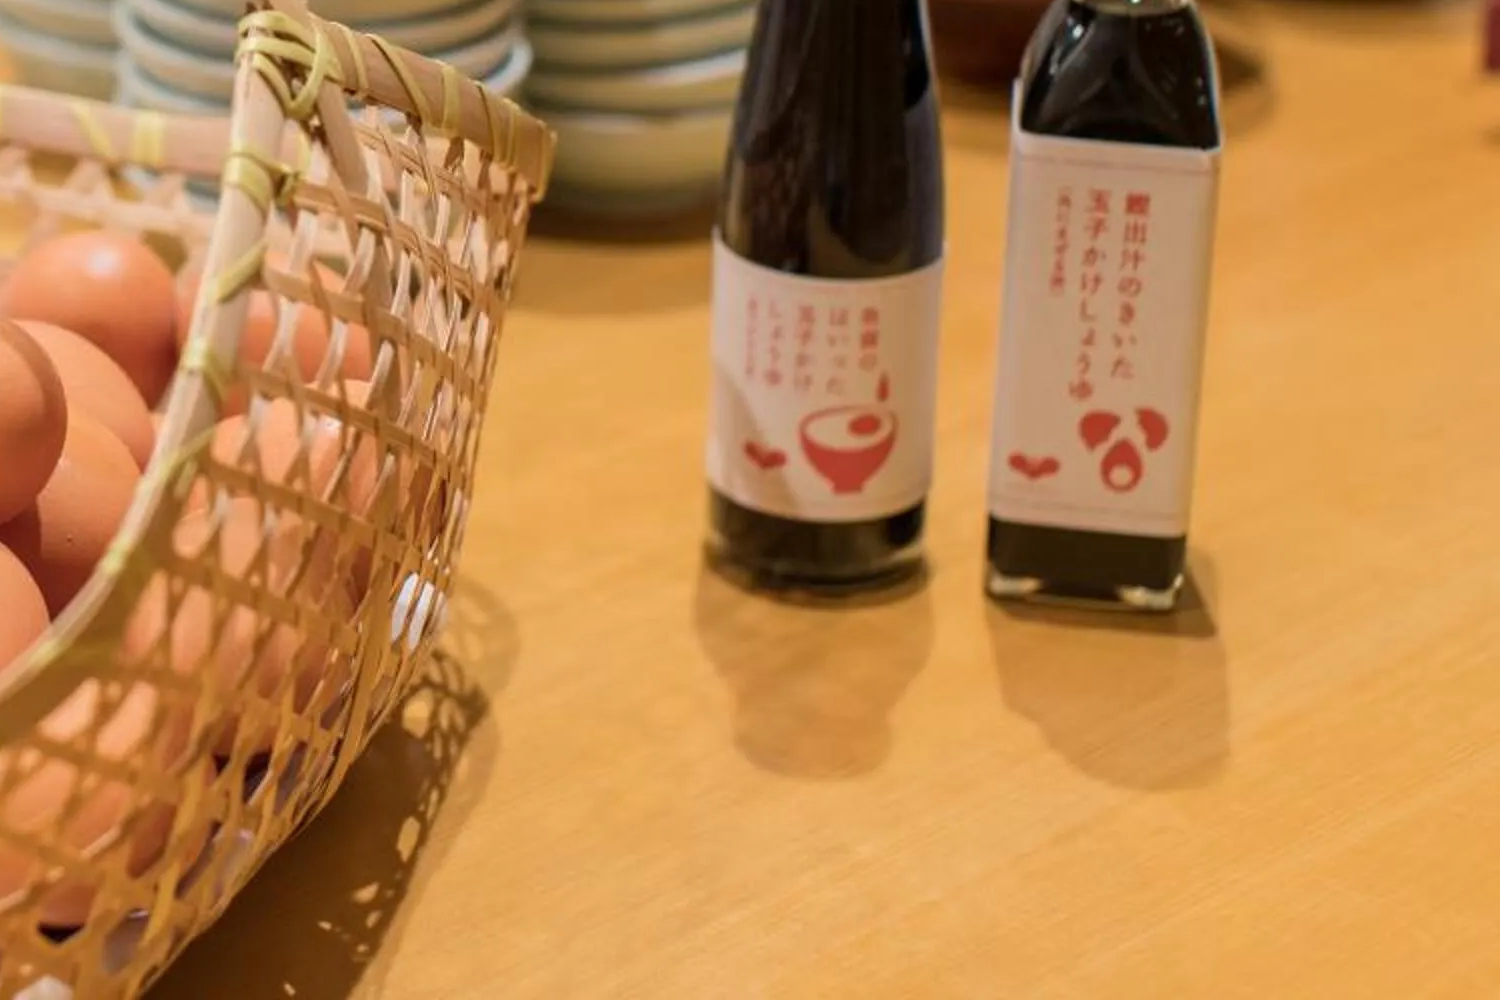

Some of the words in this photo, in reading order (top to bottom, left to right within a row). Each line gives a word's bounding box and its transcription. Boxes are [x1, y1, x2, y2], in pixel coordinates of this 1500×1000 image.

[1069, 190, 1111, 400] 玉子かけしょうゆ
